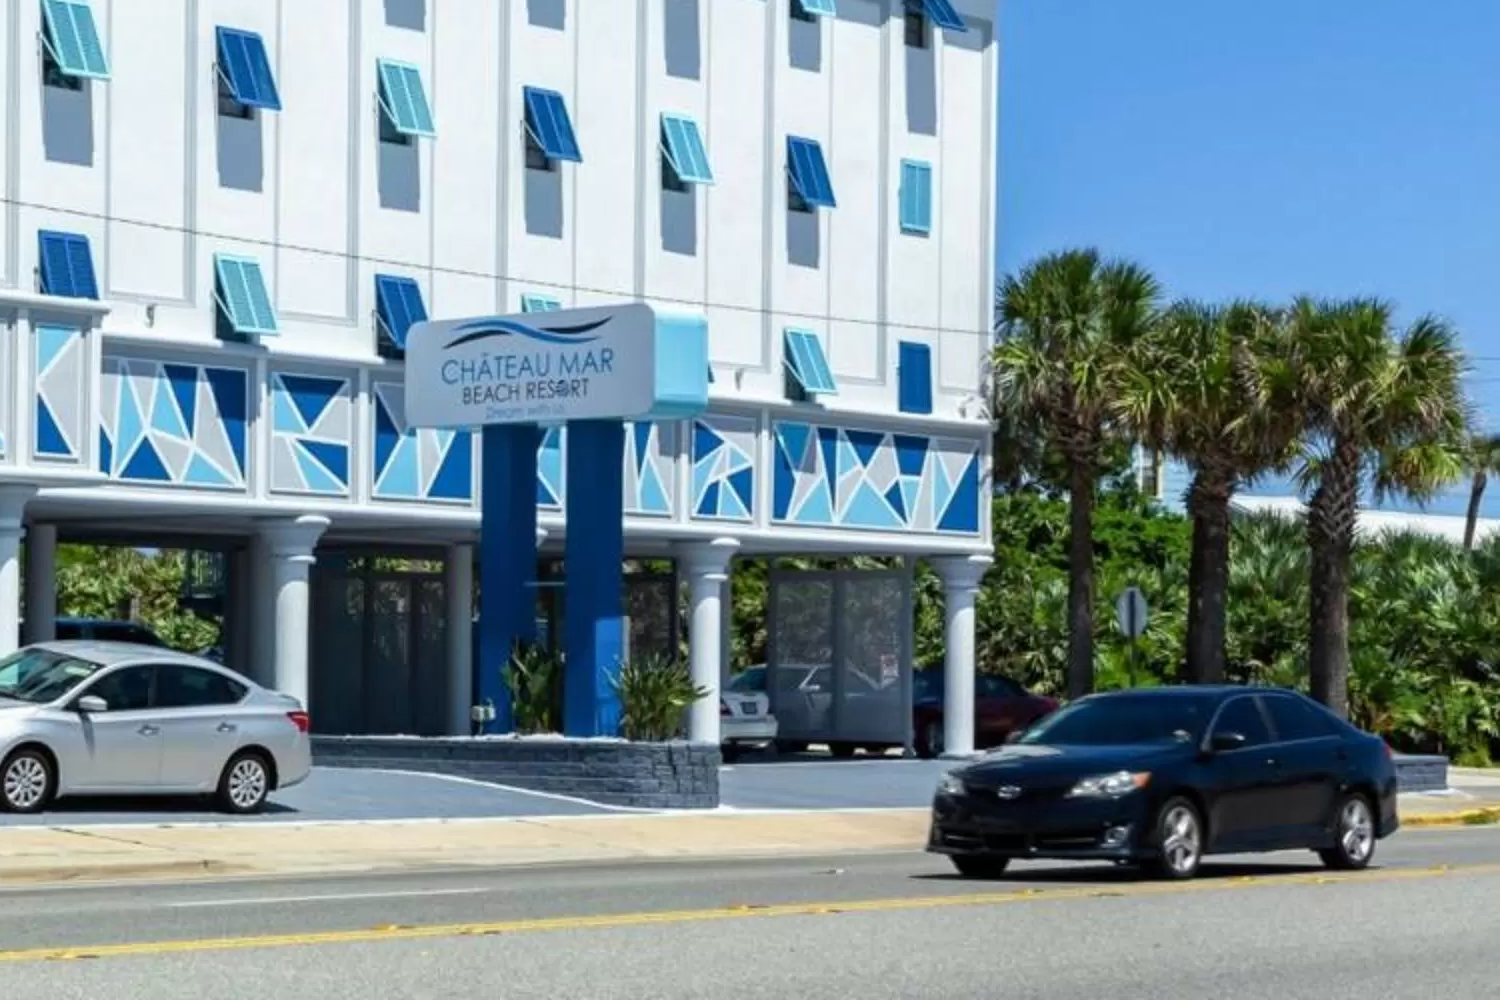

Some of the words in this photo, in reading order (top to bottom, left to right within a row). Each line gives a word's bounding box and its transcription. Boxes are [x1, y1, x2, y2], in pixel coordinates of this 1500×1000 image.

[441, 352, 550, 385] CHÂTEAU
[558, 347, 614, 375] MAR
[462, 383, 521, 406] BEACH
[525, 378, 590, 401] RESORT
